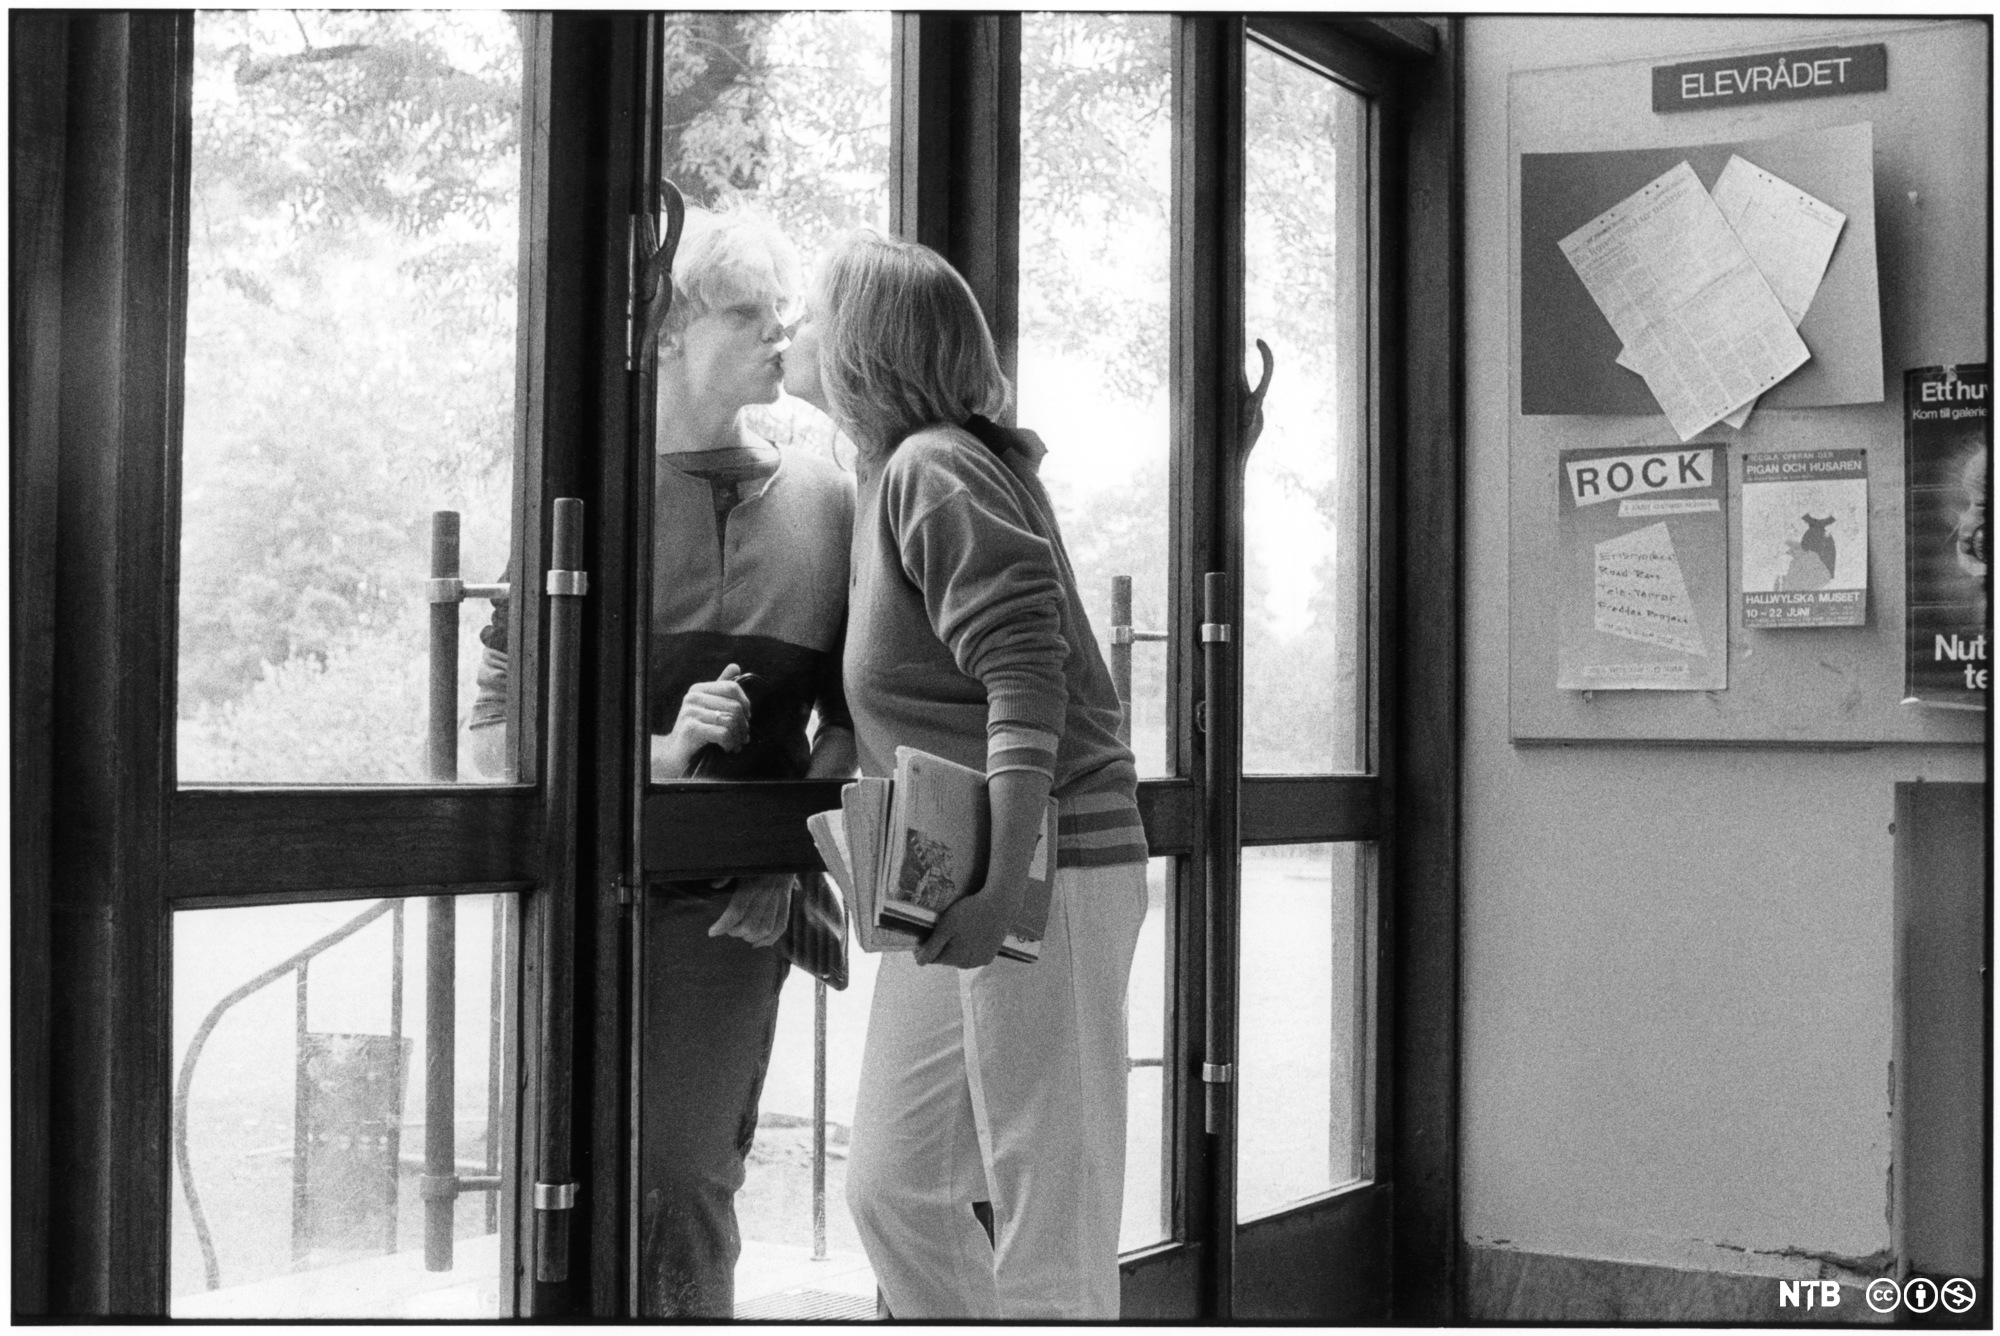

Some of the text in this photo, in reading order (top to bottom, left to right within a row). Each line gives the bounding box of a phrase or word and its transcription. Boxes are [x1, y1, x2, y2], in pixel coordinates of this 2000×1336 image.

[1681, 57, 1852, 99] ELEVRÅDET
[1922, 381, 1953, 402] Ett
[1912, 408, 1938, 420] Kom
[1576, 452, 1705, 498] ROCK
[1746, 460, 1862, 475] PIGAN OCH HUSAREN
[1745, 591, 1860, 605] HALLWYLSKA MUSEET
[1745, 608, 1759, 618] 10
[1768, 608, 1783, 618] 22
[1786, 607, 1810, 618] JUNI
[1935, 633, 1987, 661] Nut
